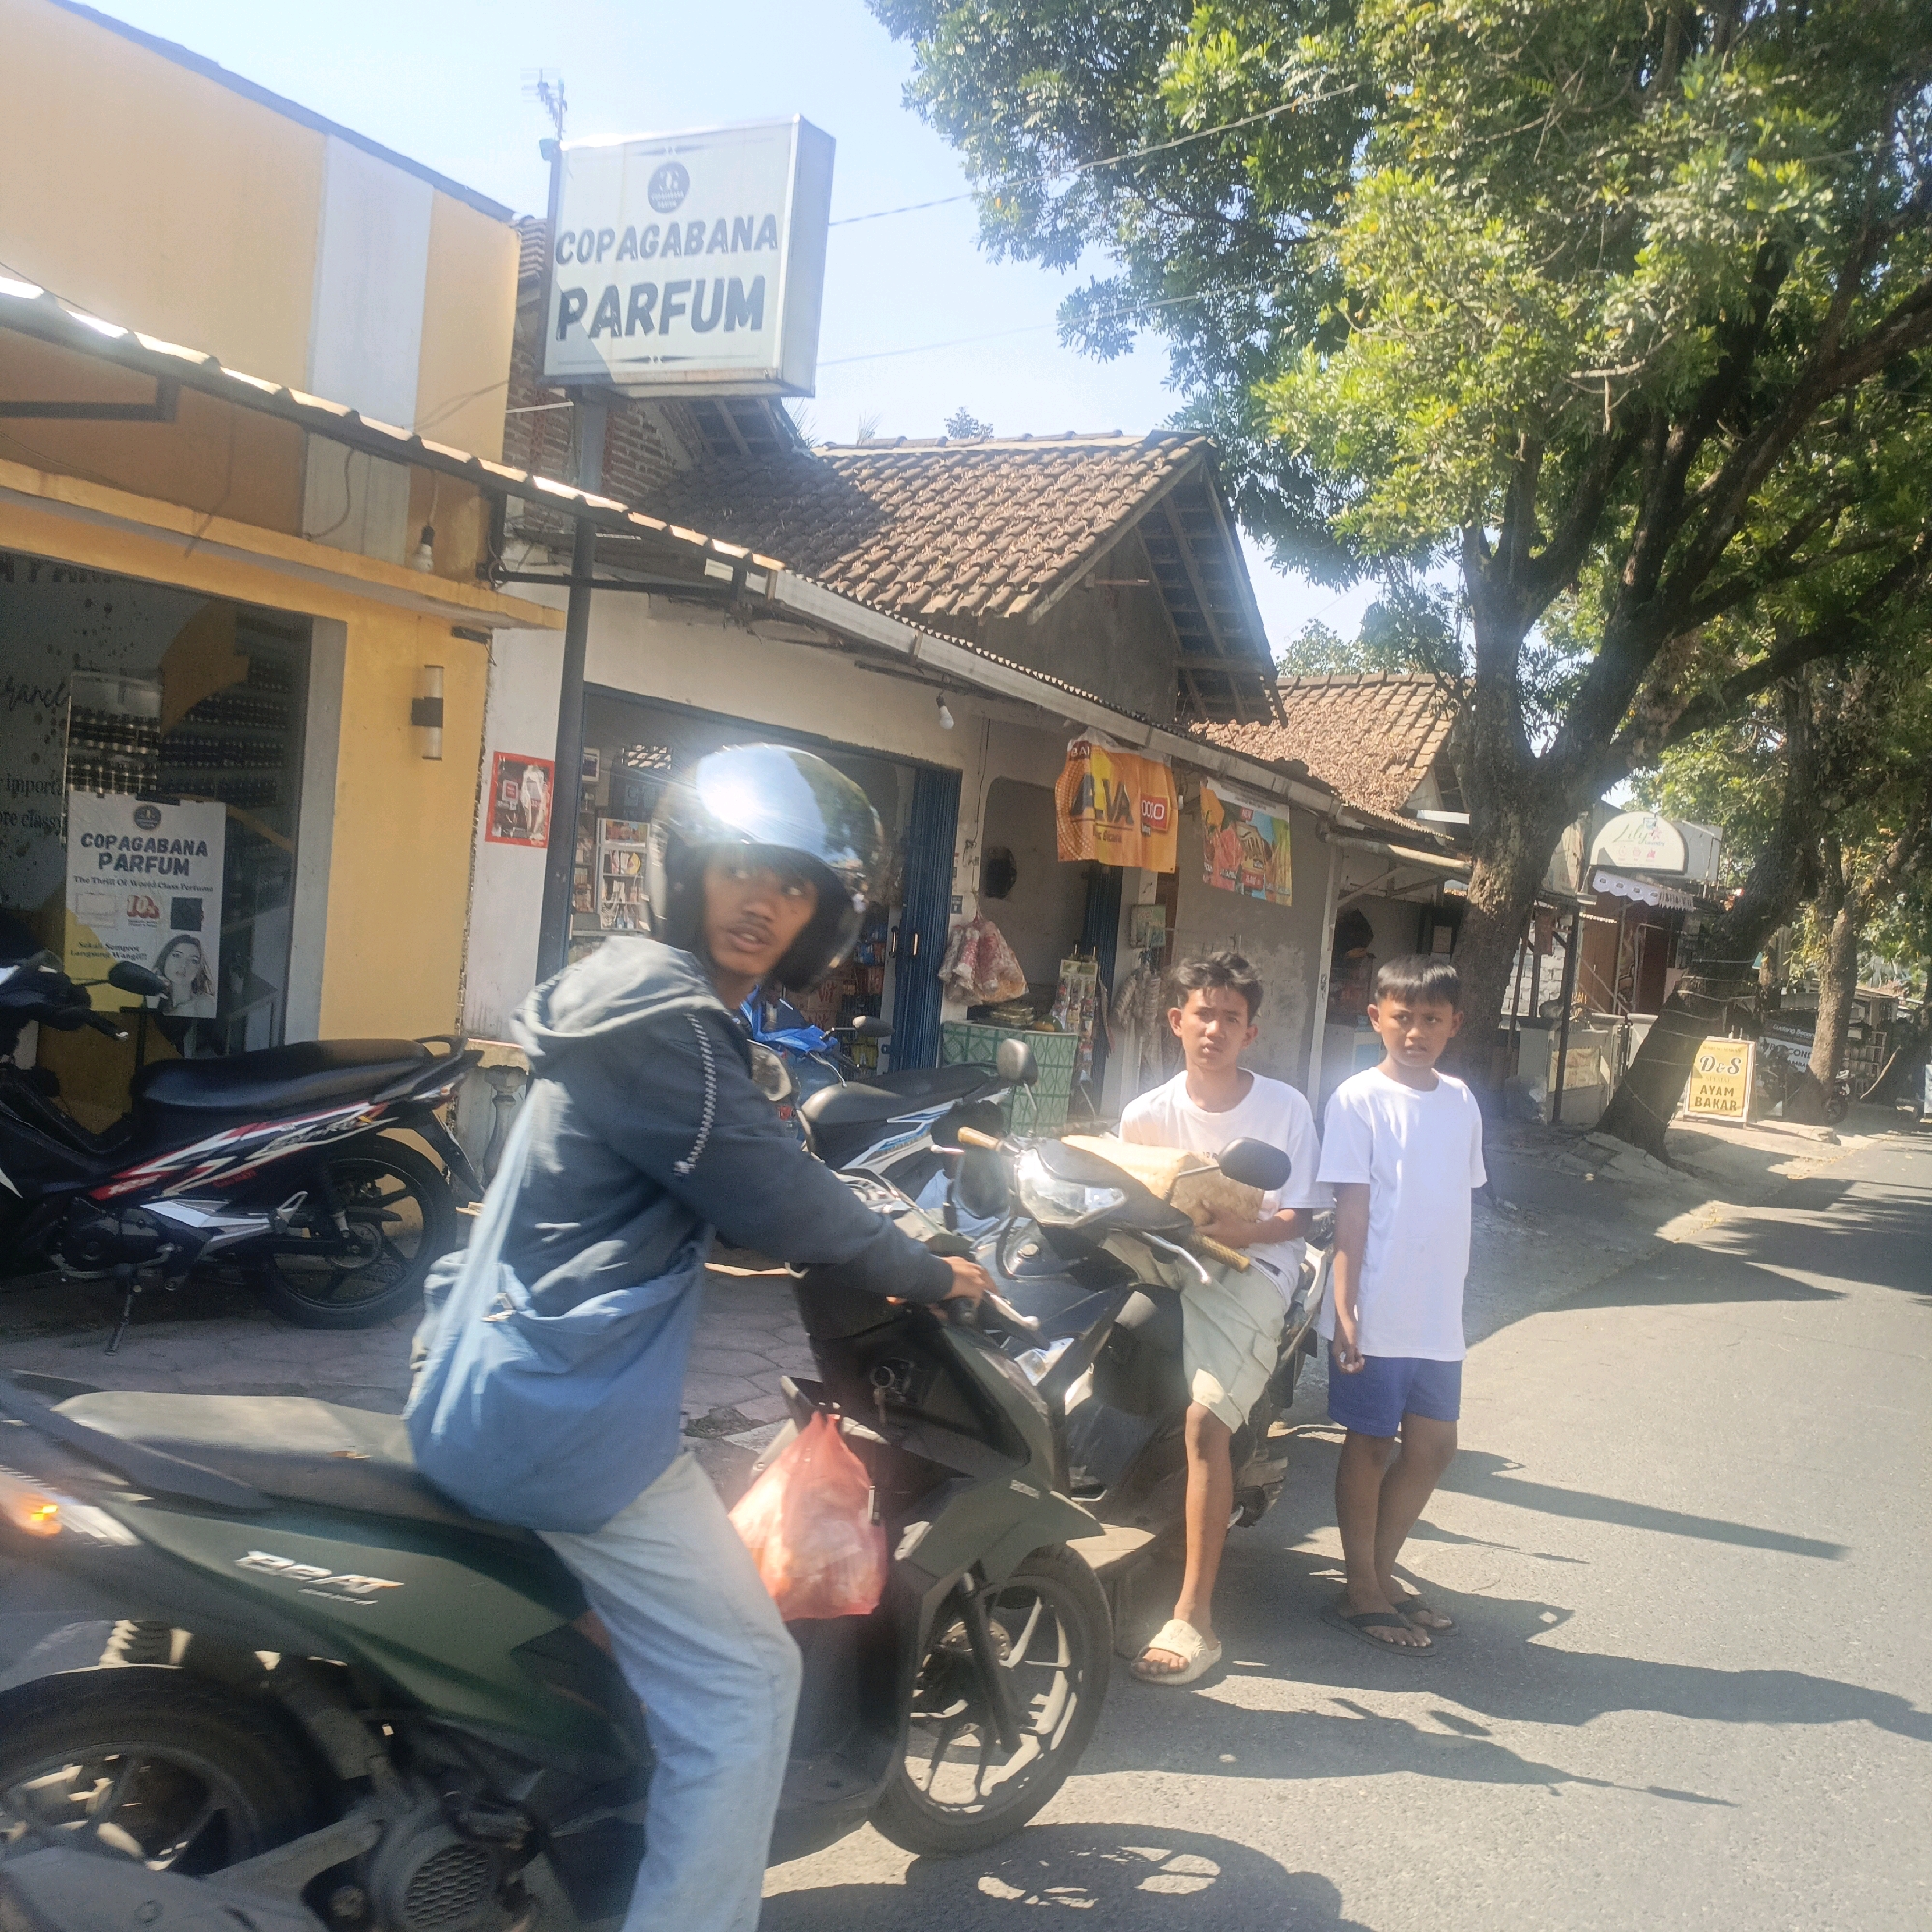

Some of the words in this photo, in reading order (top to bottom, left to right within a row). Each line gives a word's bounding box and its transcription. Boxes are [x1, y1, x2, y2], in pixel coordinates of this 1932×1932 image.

[555, 214, 778, 265] COPAGABANA
[555, 275, 766, 342] PARFUM
[80, 832, 209, 858] COPAGABANA
[98, 852, 190, 877] PARFUM
[73, 875, 90, 884] The
[1694, 1096, 1737, 1111] BAKAR
[1700, 1085, 1734, 1097] AYAM
